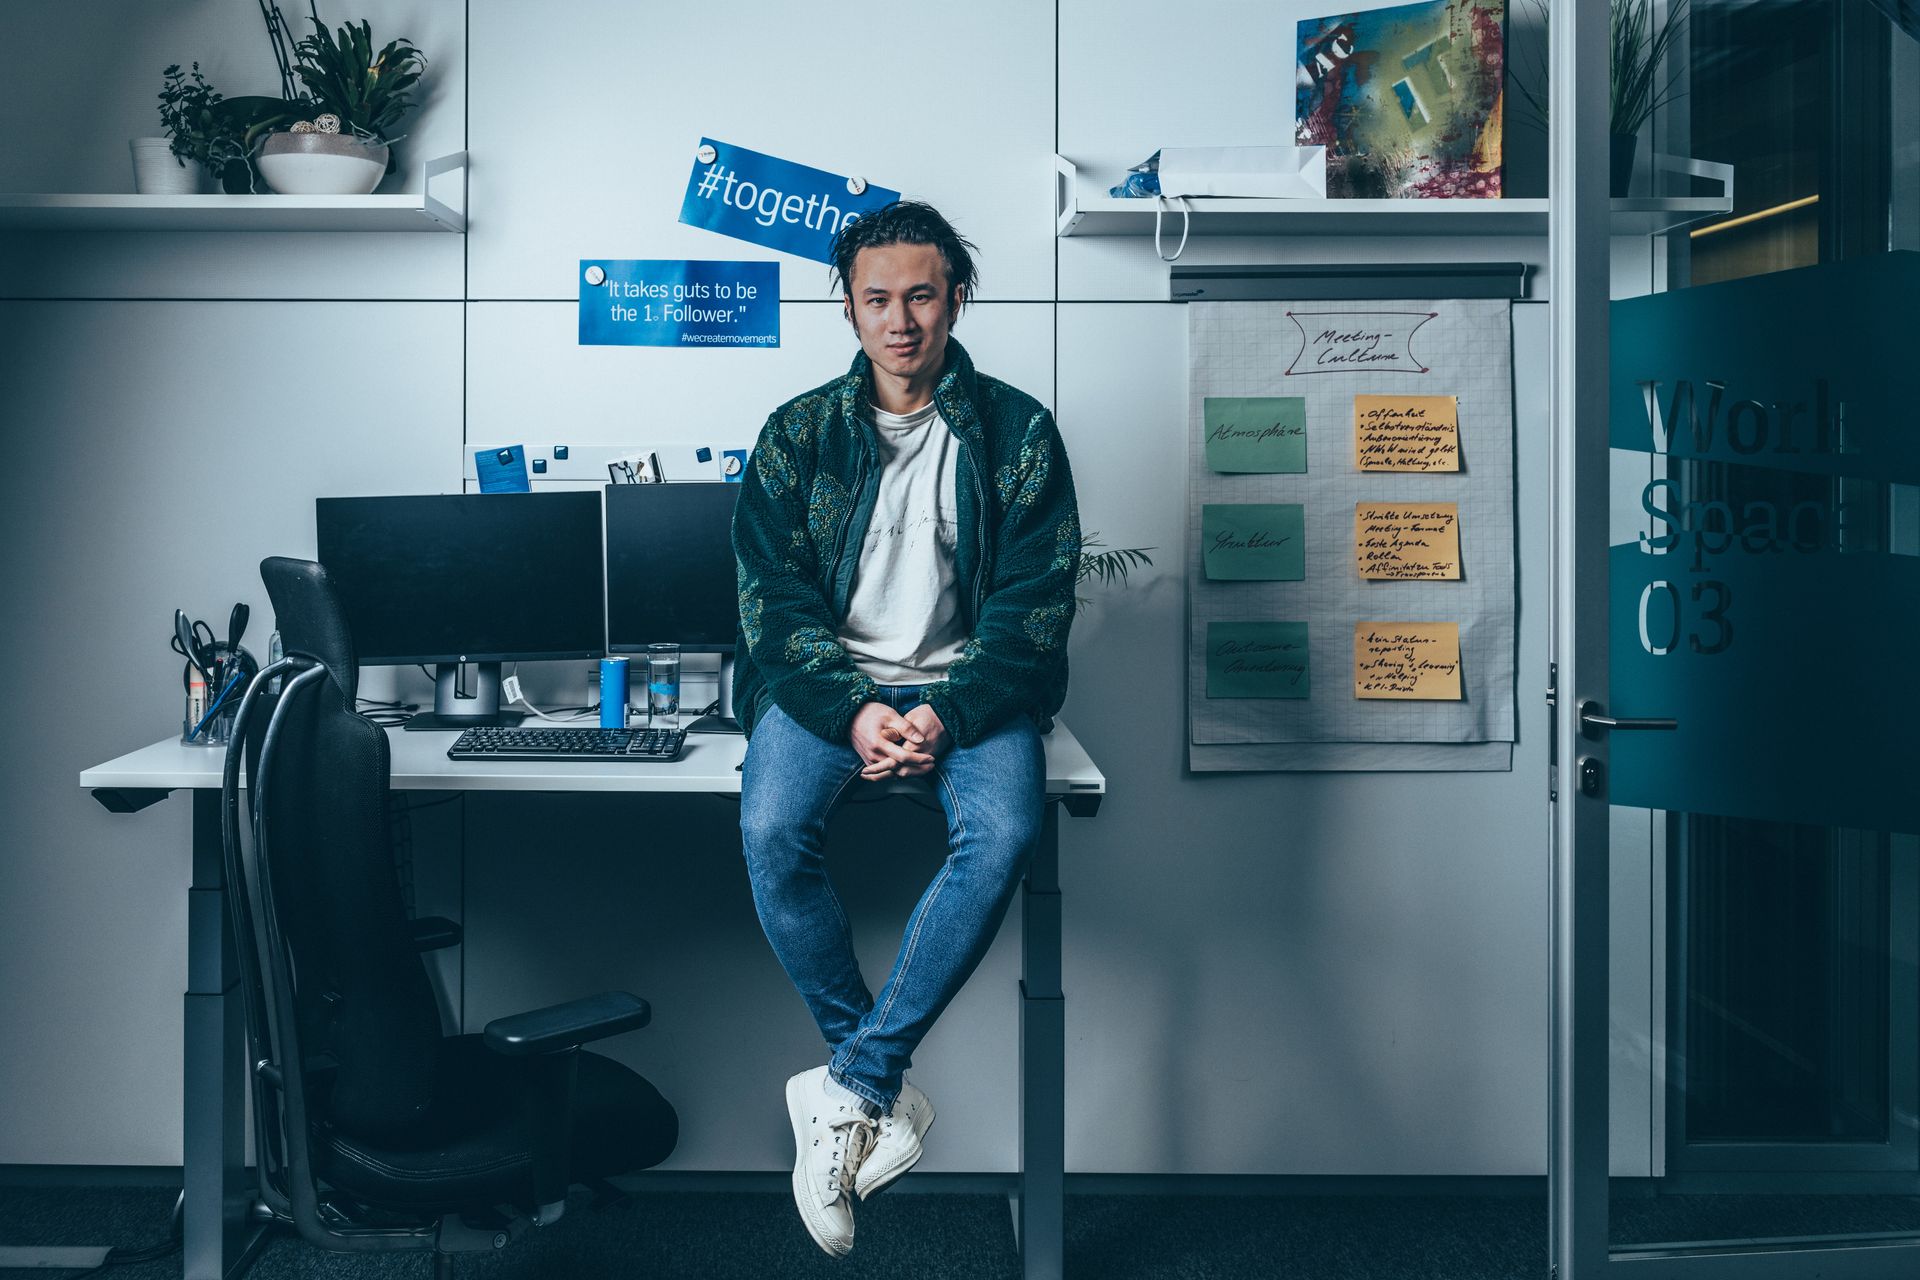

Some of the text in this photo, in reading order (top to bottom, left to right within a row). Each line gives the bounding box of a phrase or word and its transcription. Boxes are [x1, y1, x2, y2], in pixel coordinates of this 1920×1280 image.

[601, 280, 758, 302] "It takes guts to be
[610, 304, 637, 322] the
[663, 304, 747, 324] Follower."
[681, 332, 777, 345] #wecreatemovements
[1313, 329, 1393, 350] Meeting-
[1317, 347, 1400, 366] Culture
[1403, 511, 1454, 525] Umsetzung
[1390, 538, 1430, 552] Agenda
[1638, 580, 1733, 655] 03
